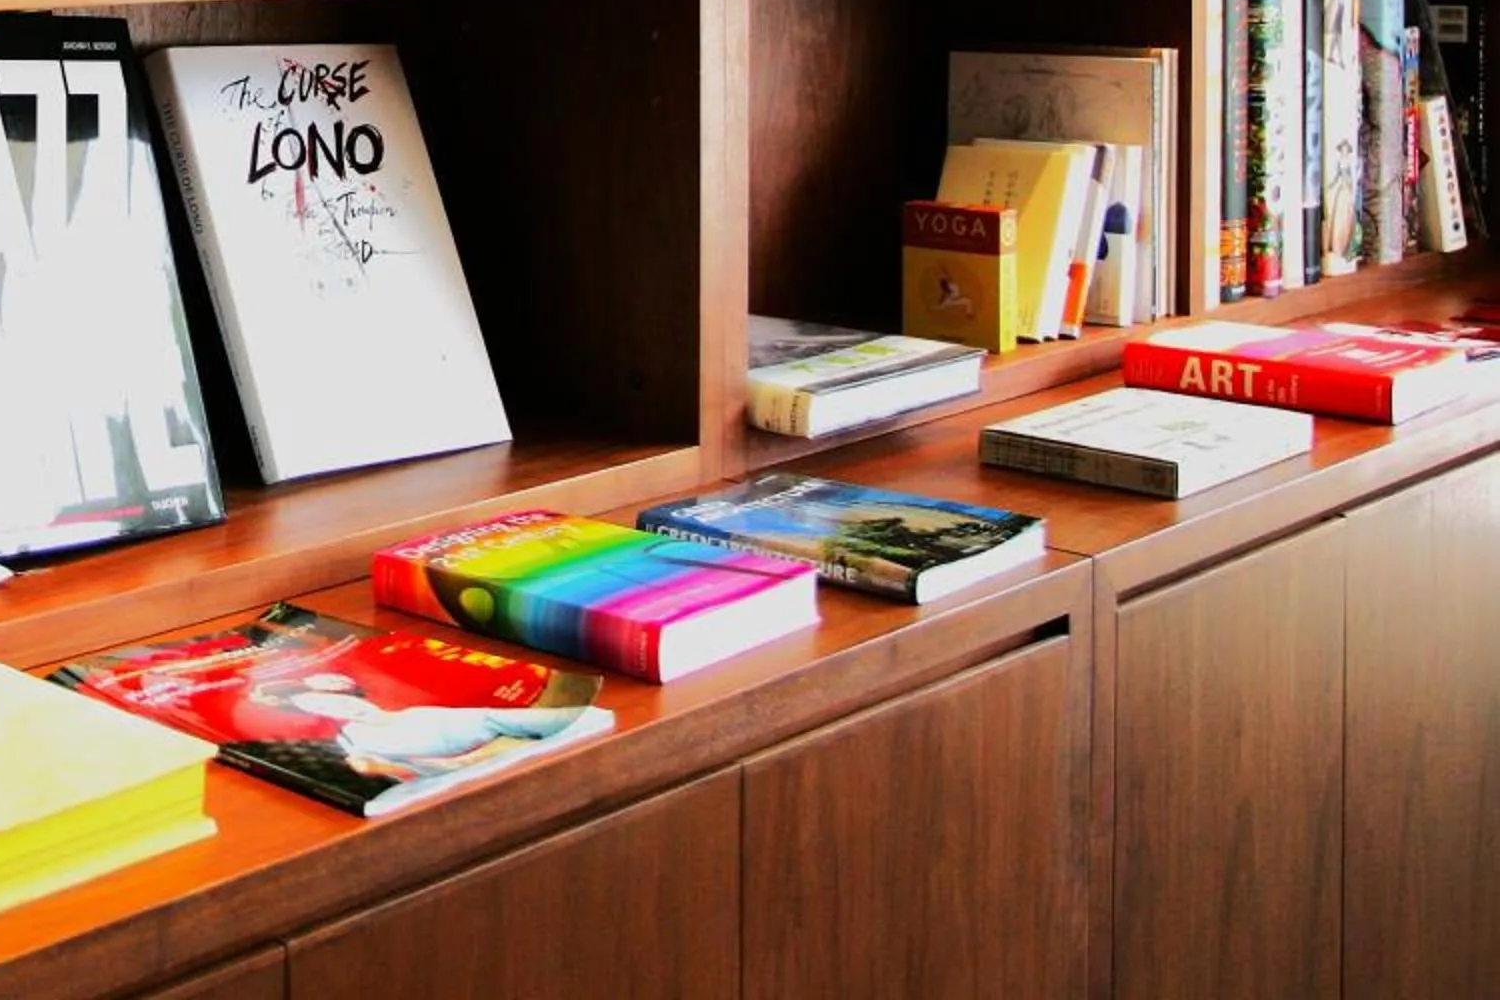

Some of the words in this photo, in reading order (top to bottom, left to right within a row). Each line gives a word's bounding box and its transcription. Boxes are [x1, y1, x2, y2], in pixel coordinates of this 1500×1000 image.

[220, 75, 276, 110] The
[278, 58, 371, 111] CURSE
[248, 120, 384, 184] LONO
[914, 211, 987, 238] YOGA
[1180, 356, 1262, 398] ART
[394, 521, 510, 561] Designing
